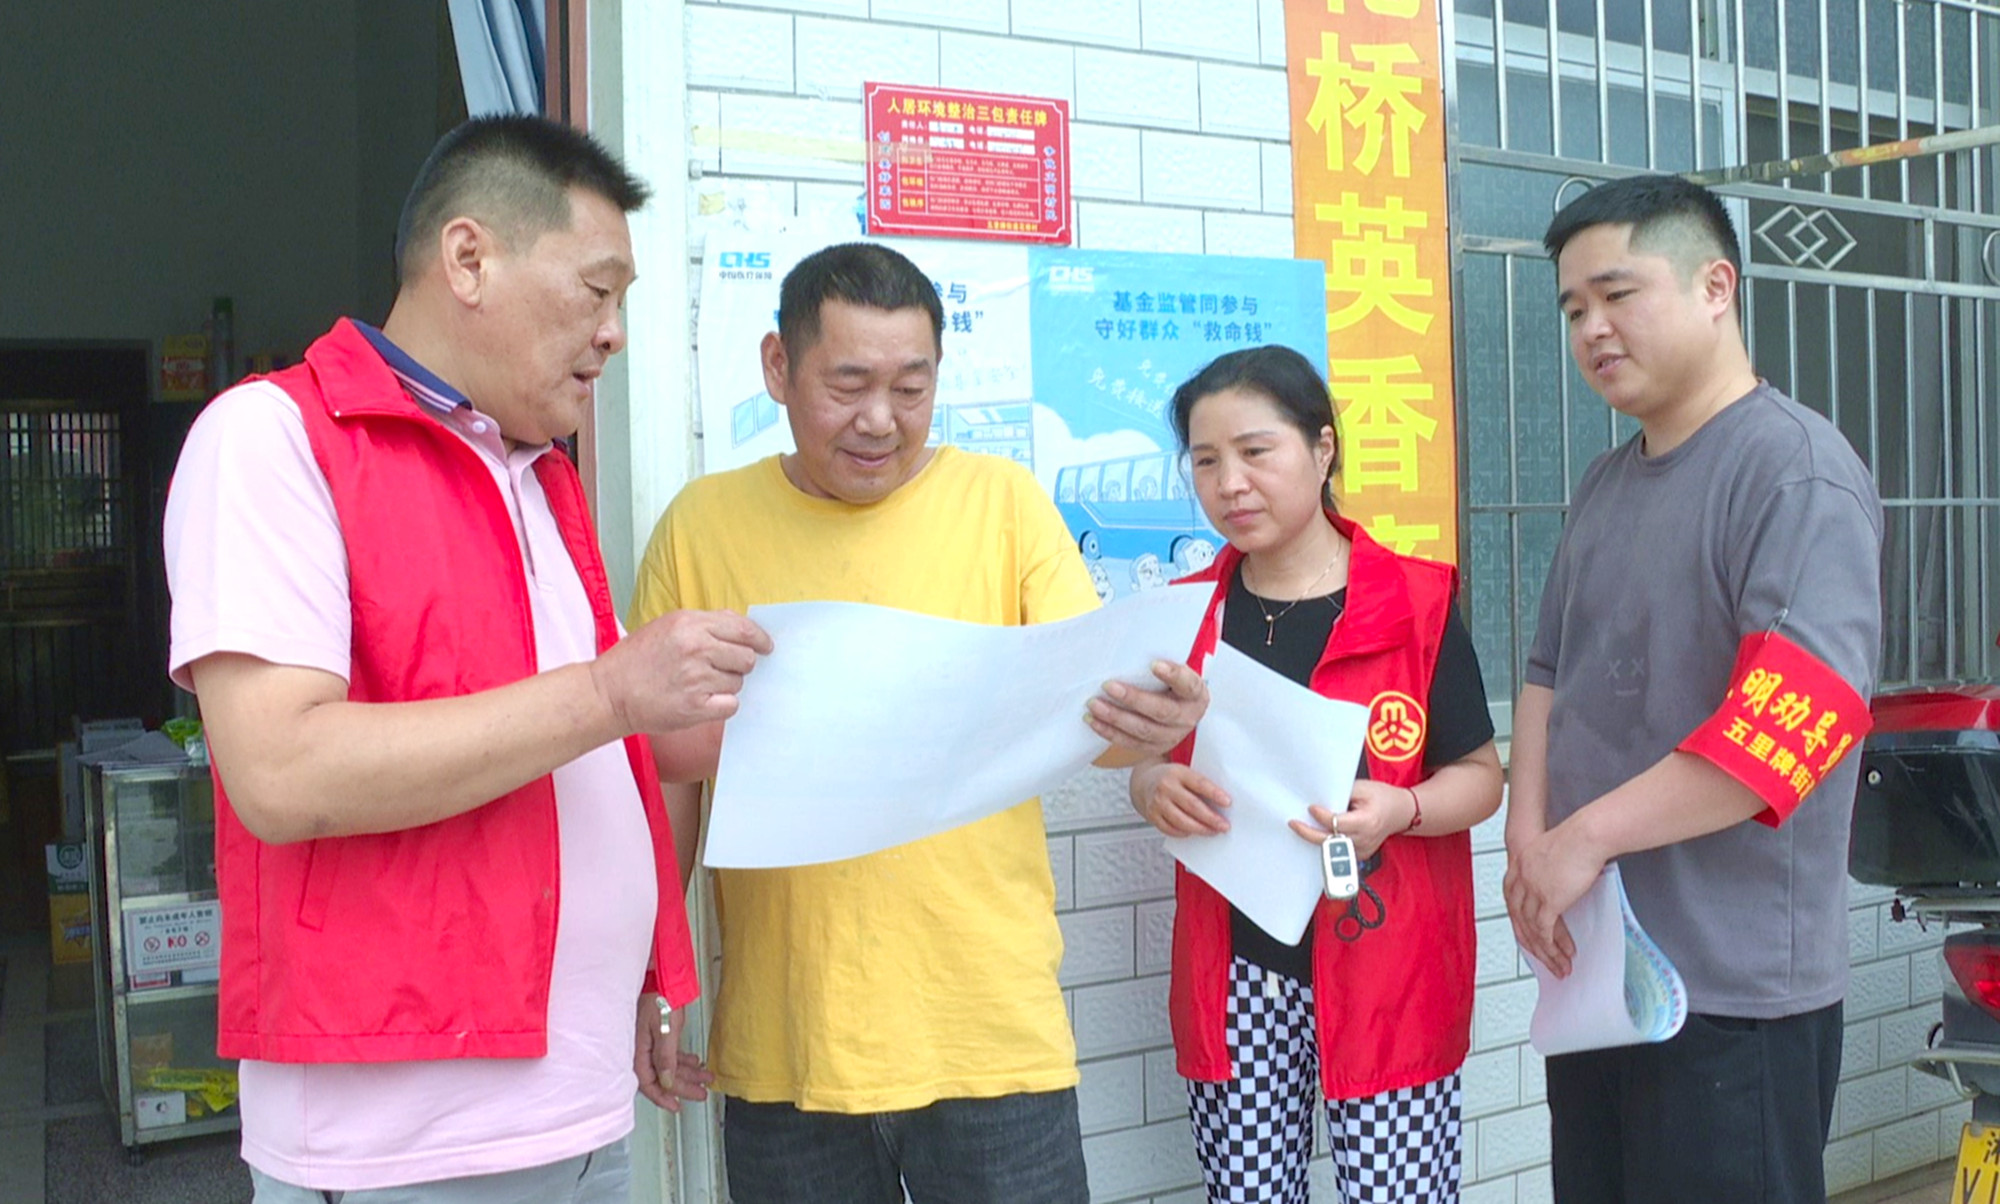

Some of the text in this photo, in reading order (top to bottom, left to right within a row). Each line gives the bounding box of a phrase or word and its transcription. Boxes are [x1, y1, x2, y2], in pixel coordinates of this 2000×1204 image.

[887, 97, 1048, 127] 人居环境整治三包责任牌
[1305, 0, 1441, 561] 桥英香
[1112, 289, 1259, 316] 基金监管同参与
